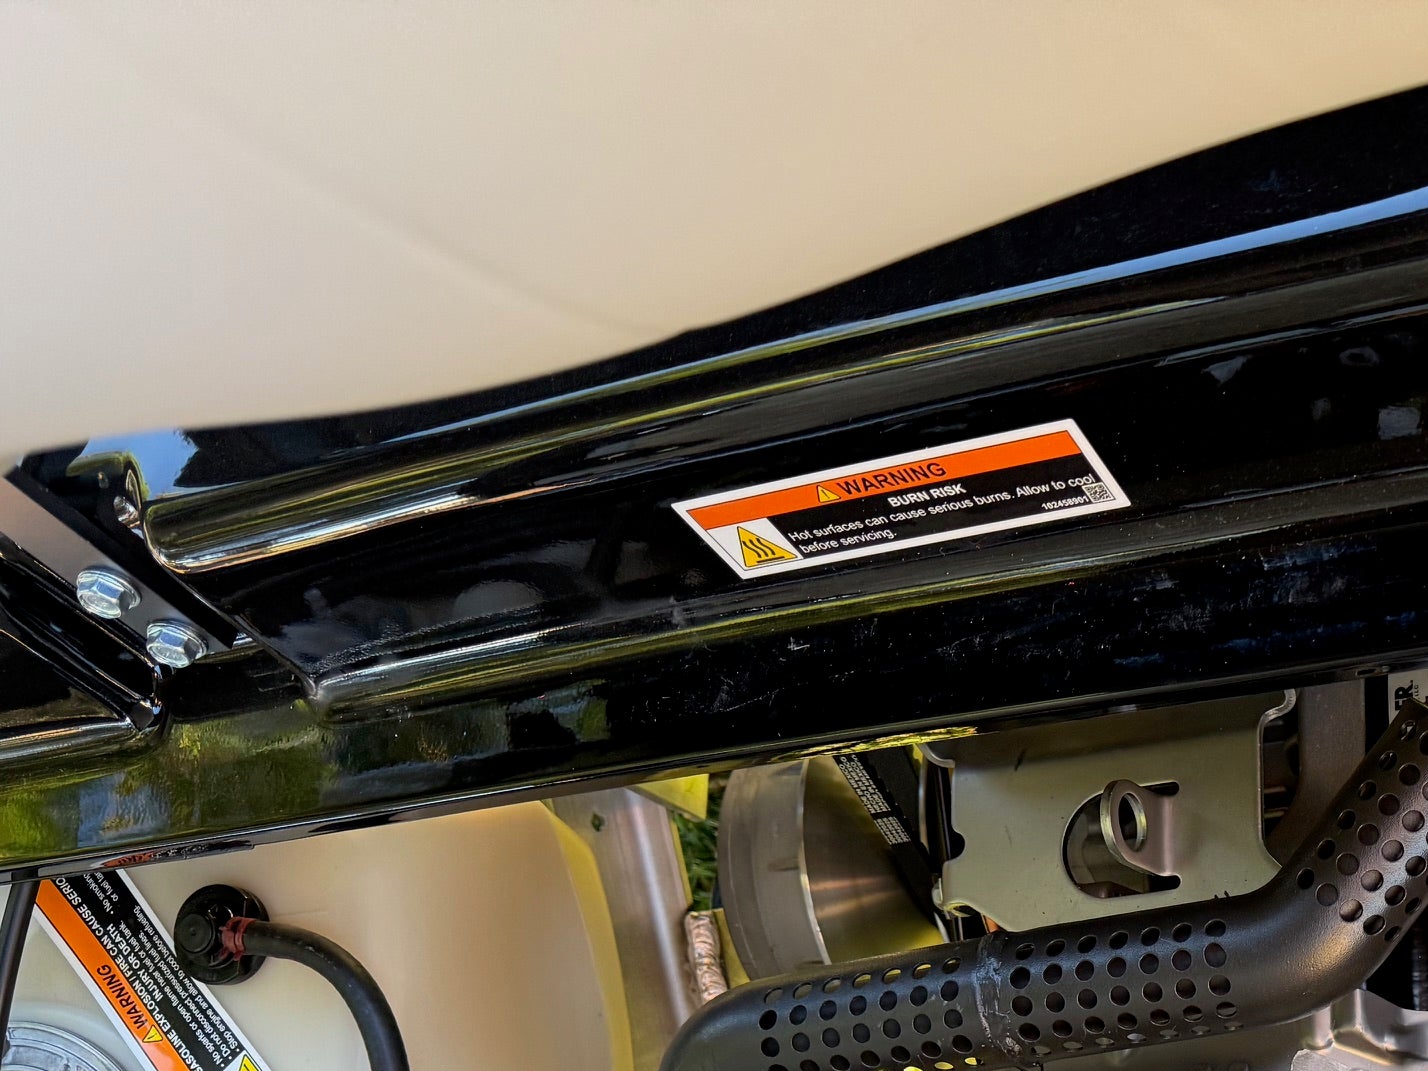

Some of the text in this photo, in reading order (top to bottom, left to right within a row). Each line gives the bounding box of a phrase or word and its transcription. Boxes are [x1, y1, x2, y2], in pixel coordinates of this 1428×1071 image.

[837, 462, 947, 495] WARNING
[887, 483, 966, 506] BURN RISK
[787, 473, 1096, 541] Hot surfaces can cause serious burns. Allow to cool
[798, 528, 898, 553] before servicing.
[55, 876, 81, 906] SERIO
[76, 903, 103, 937] CAUSE
[100, 935, 117, 956] CAN
[106, 923, 163, 1001] INJURY OR DEATH
[114, 954, 132, 977] FIRE
[132, 904, 238, 1049] Stop engine and allow to cool before refueling.
[96, 963, 147, 1028] WARNING
[132, 979, 170, 1031] EXPLOSION
